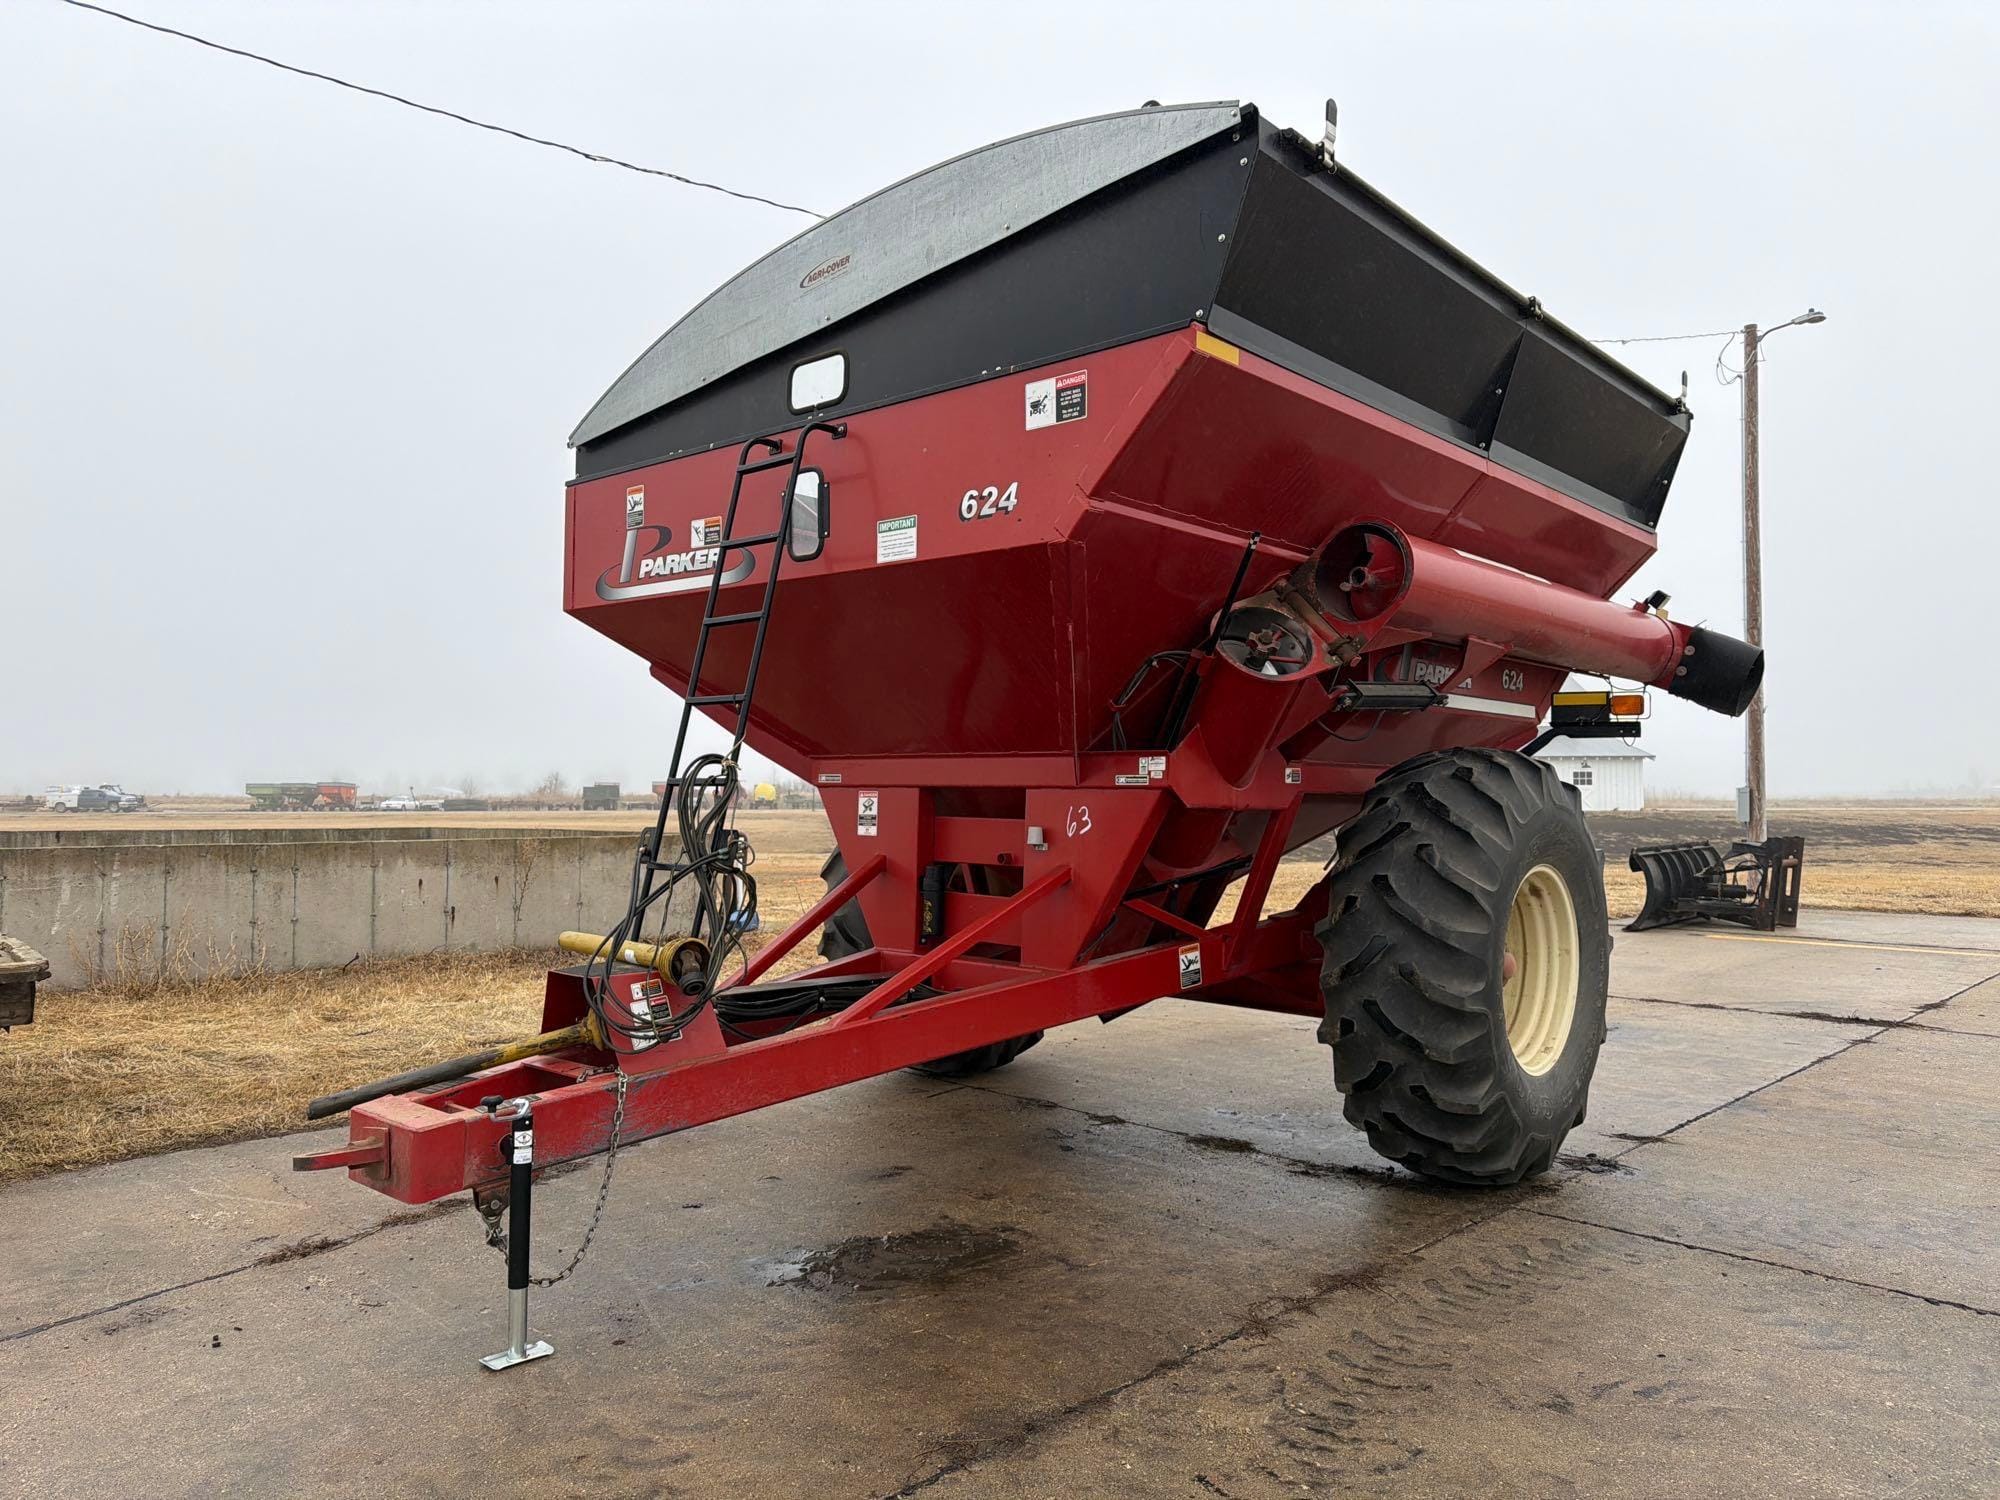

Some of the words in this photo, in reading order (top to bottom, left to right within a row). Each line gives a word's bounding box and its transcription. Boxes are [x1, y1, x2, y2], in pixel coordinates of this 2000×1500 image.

[807, 255, 851, 284] AGRI-COVER
[1062, 374, 1086, 385] DANGER
[959, 481, 1018, 519] 624
[879, 517, 915, 532] IMPORTANT
[638, 547, 721, 579] PARKER
[1502, 669, 1524, 692] 624
[1066, 806, 1092, 838] 63
